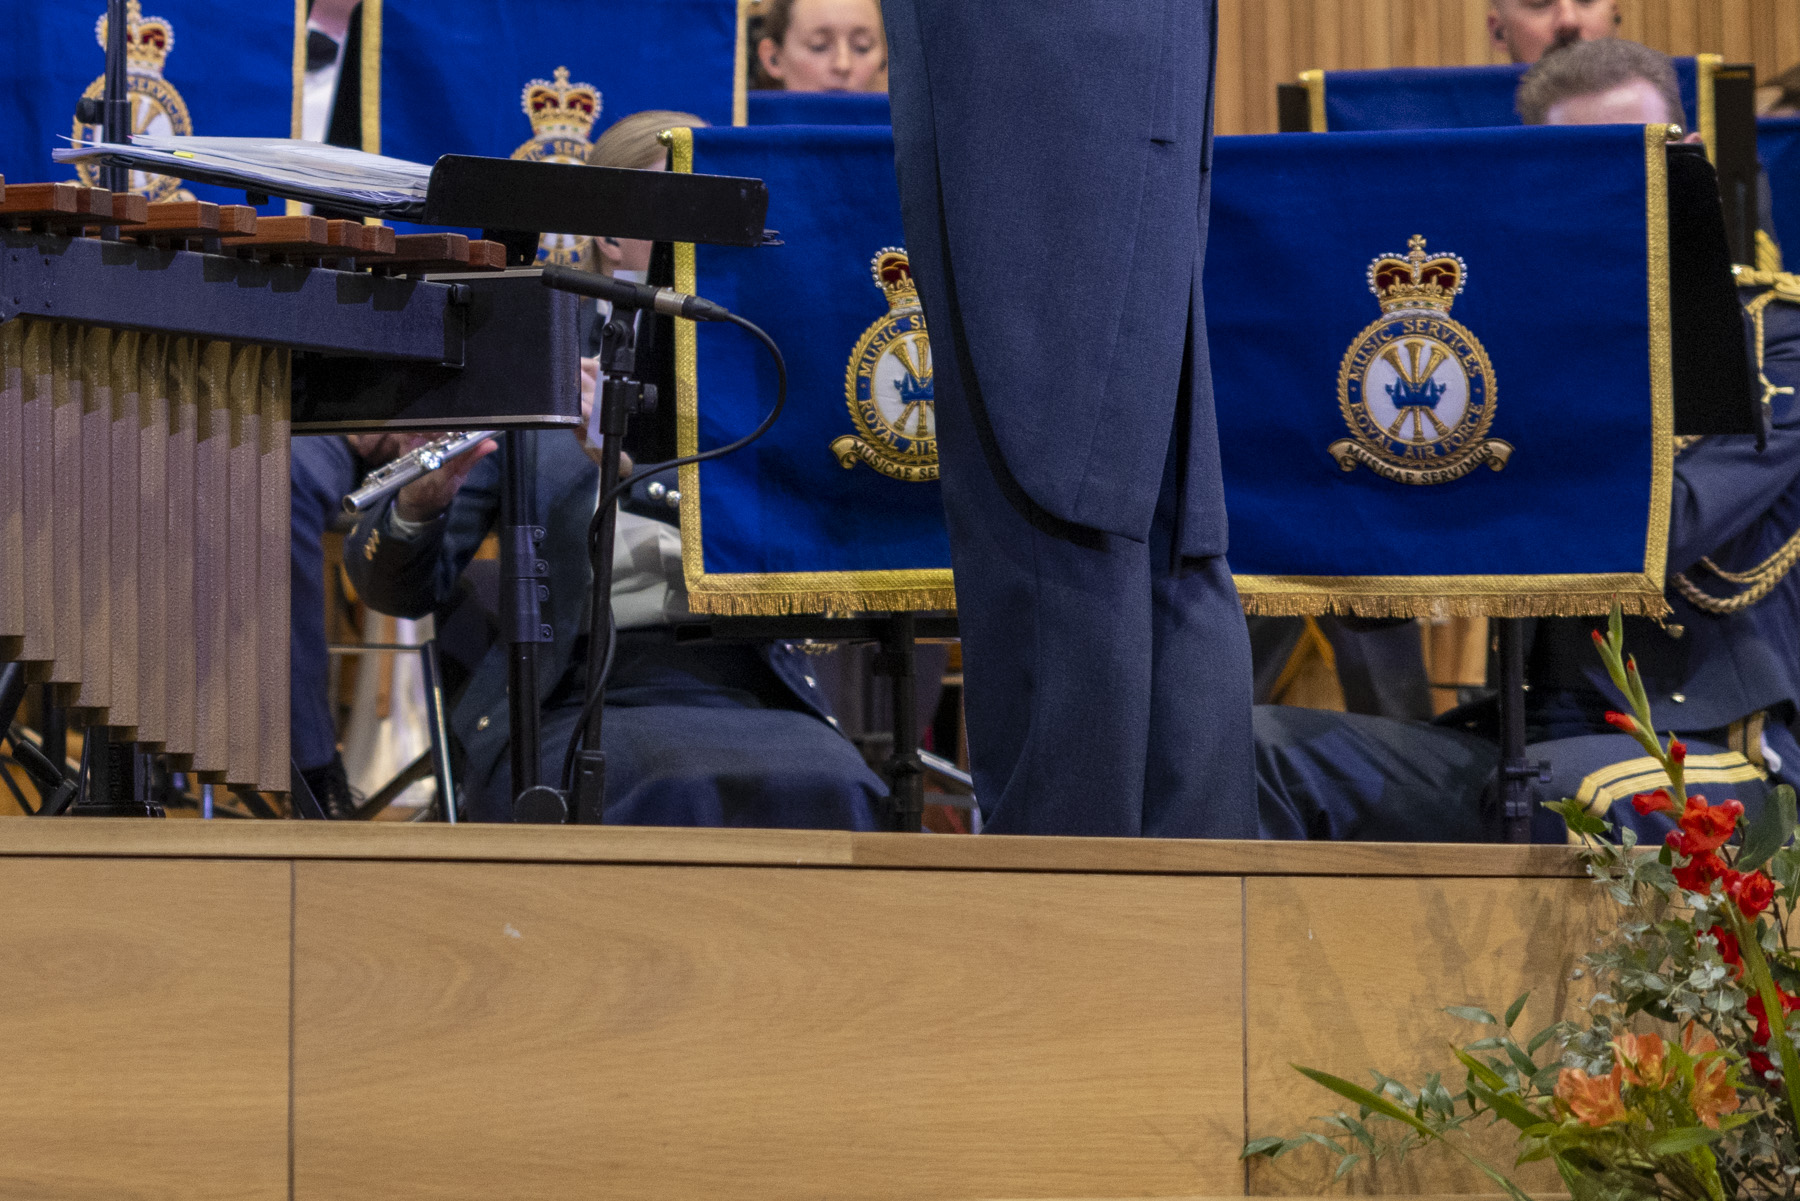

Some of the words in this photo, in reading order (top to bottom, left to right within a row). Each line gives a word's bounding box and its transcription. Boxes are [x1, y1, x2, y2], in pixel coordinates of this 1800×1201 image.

[858, 322, 901, 379] MUSIC
[1348, 325, 1394, 382] MUSIC
[1402, 319, 1482, 378] SERVICES
[858, 400, 900, 451] ROYAL
[905, 439, 938, 456] AIR
[1351, 402, 1395, 453] ROYAL
[1402, 445, 1440, 460] AIR
[1441, 402, 1484, 453] FORCE
[852, 438, 913, 480] MUSICAE
[1346, 444, 1415, 483] MUSICAE
[1421, 443, 1494, 484] SERVIMUS
